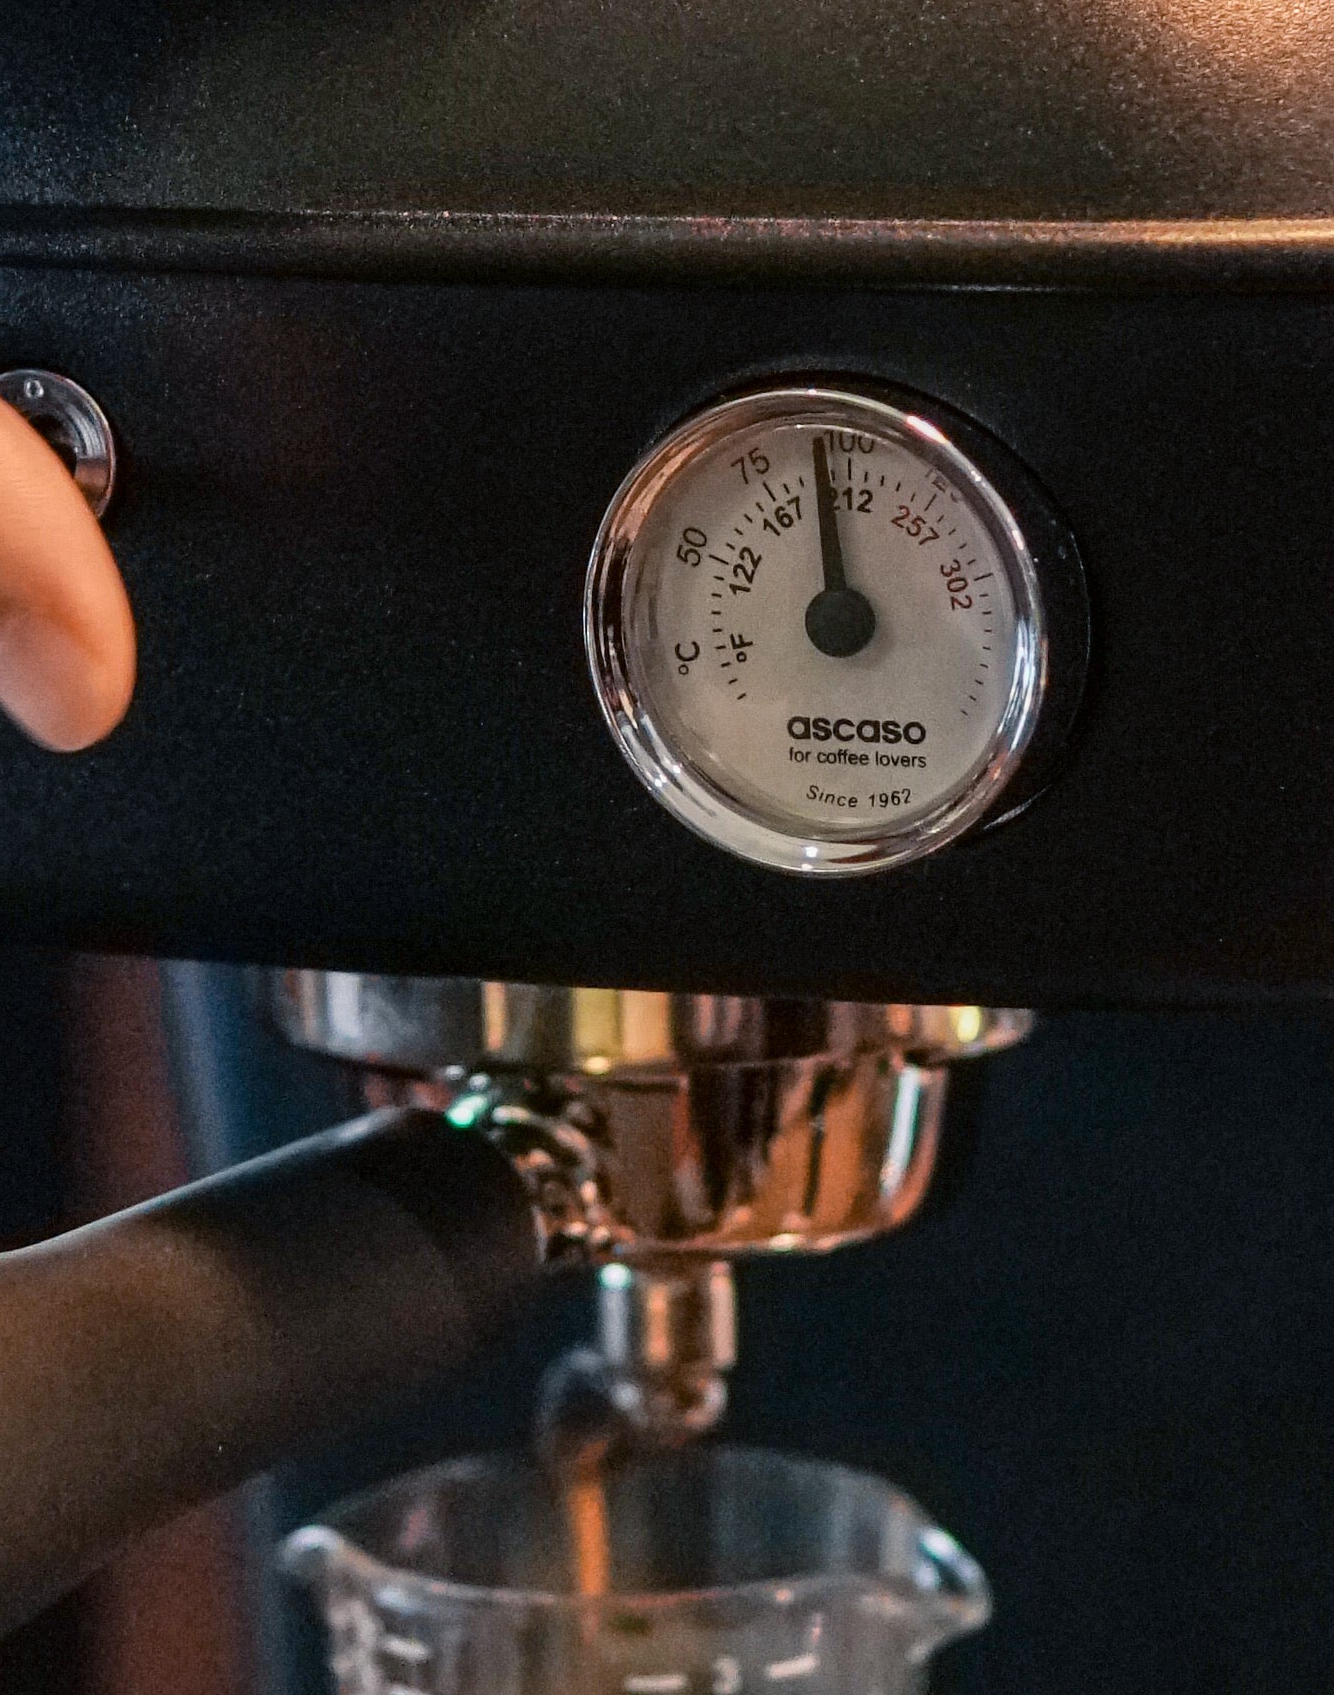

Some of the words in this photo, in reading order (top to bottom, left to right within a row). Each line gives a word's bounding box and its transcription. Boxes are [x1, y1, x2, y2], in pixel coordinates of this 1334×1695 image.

[730, 446, 770, 485] 75
[763, 496, 802, 537] 167
[890, 505, 940, 546] 257
[676, 526, 708, 567] 50
[729, 546, 762, 595] 122
[940, 558, 973, 611] 302
[786, 715, 927, 745] ascaso
[788, 746, 812, 763] for
[817, 748, 870, 766] coffee
[874, 750, 927, 769] lovers
[806, 784, 859, 808] Since
[868, 787, 912, 808] 1962
